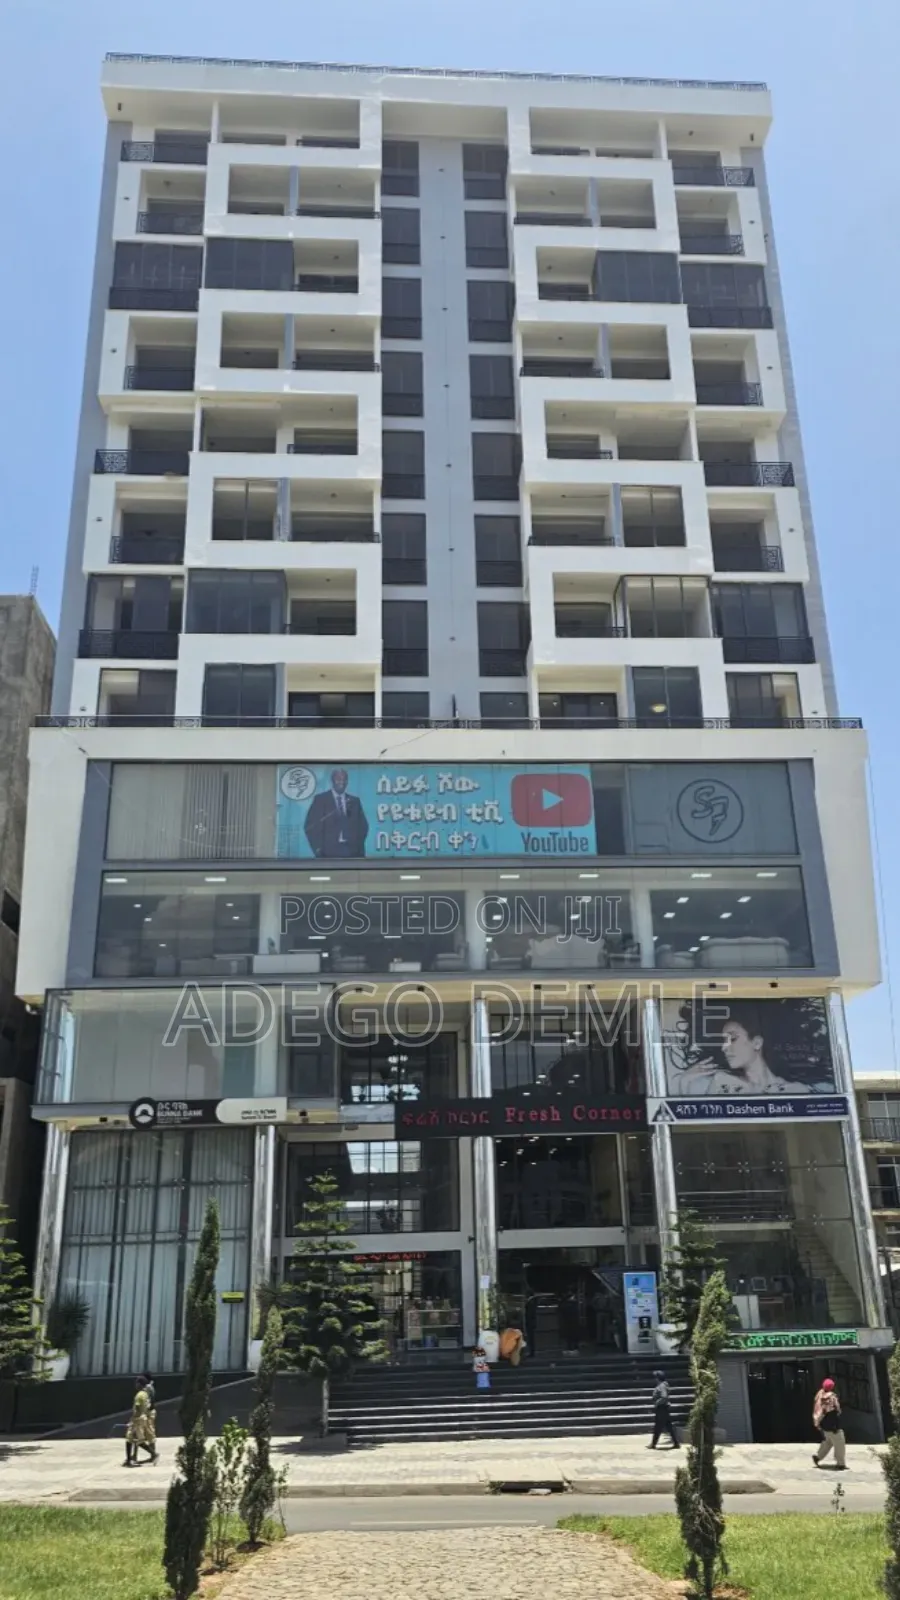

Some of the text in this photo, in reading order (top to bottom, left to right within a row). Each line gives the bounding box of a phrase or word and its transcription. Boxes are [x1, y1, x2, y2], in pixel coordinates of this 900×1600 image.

[520, 831, 590, 853] YouTube
[504, 1104, 644, 1123] Fresh Corner
[726, 1103, 766, 1115] Dashen
[768, 1102, 794, 1114] Bank
